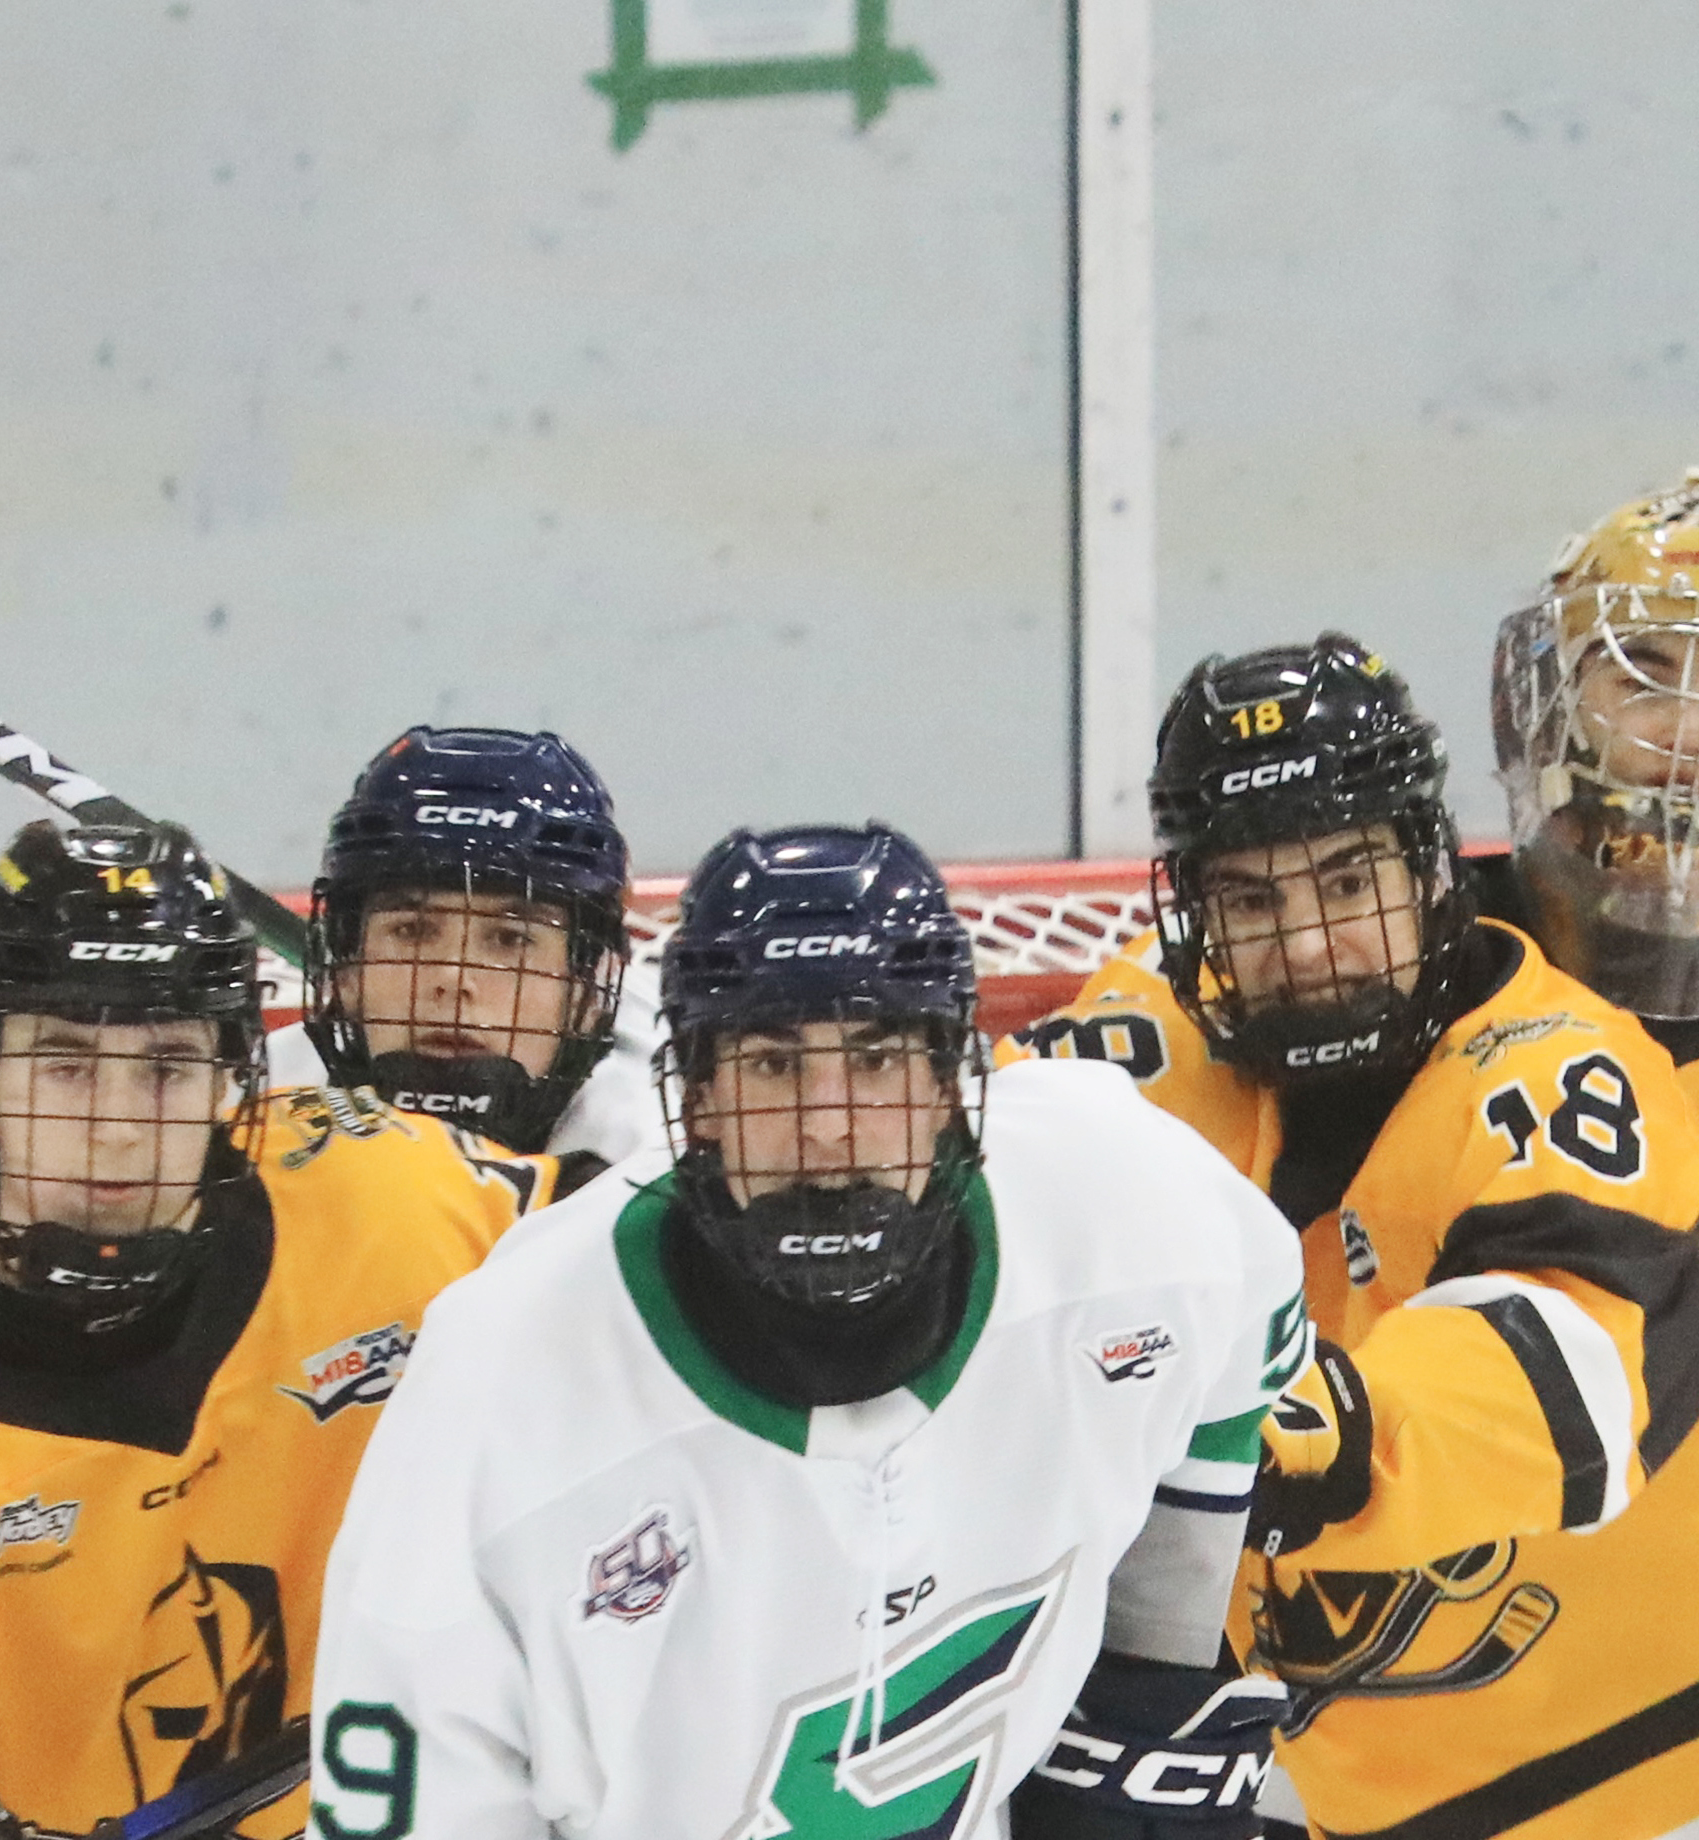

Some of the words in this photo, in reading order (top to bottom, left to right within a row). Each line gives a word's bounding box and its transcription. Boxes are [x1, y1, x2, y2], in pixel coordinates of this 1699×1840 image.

[1230, 700, 1284, 740] 18
[1221, 755, 1317, 796] CCM
[416, 804, 518, 829] CCM
[98, 866, 153, 894] 14
[69, 941, 178, 963] CCM
[764, 934, 871, 960] CCM
[1287, 1030, 1380, 1068] CCM
[393, 1090, 492, 1114] CCM
[1481, 1049, 1648, 1187] 18
[778, 1231, 884, 1256] CCM
[1033, 1729, 1275, 1807] CCM
